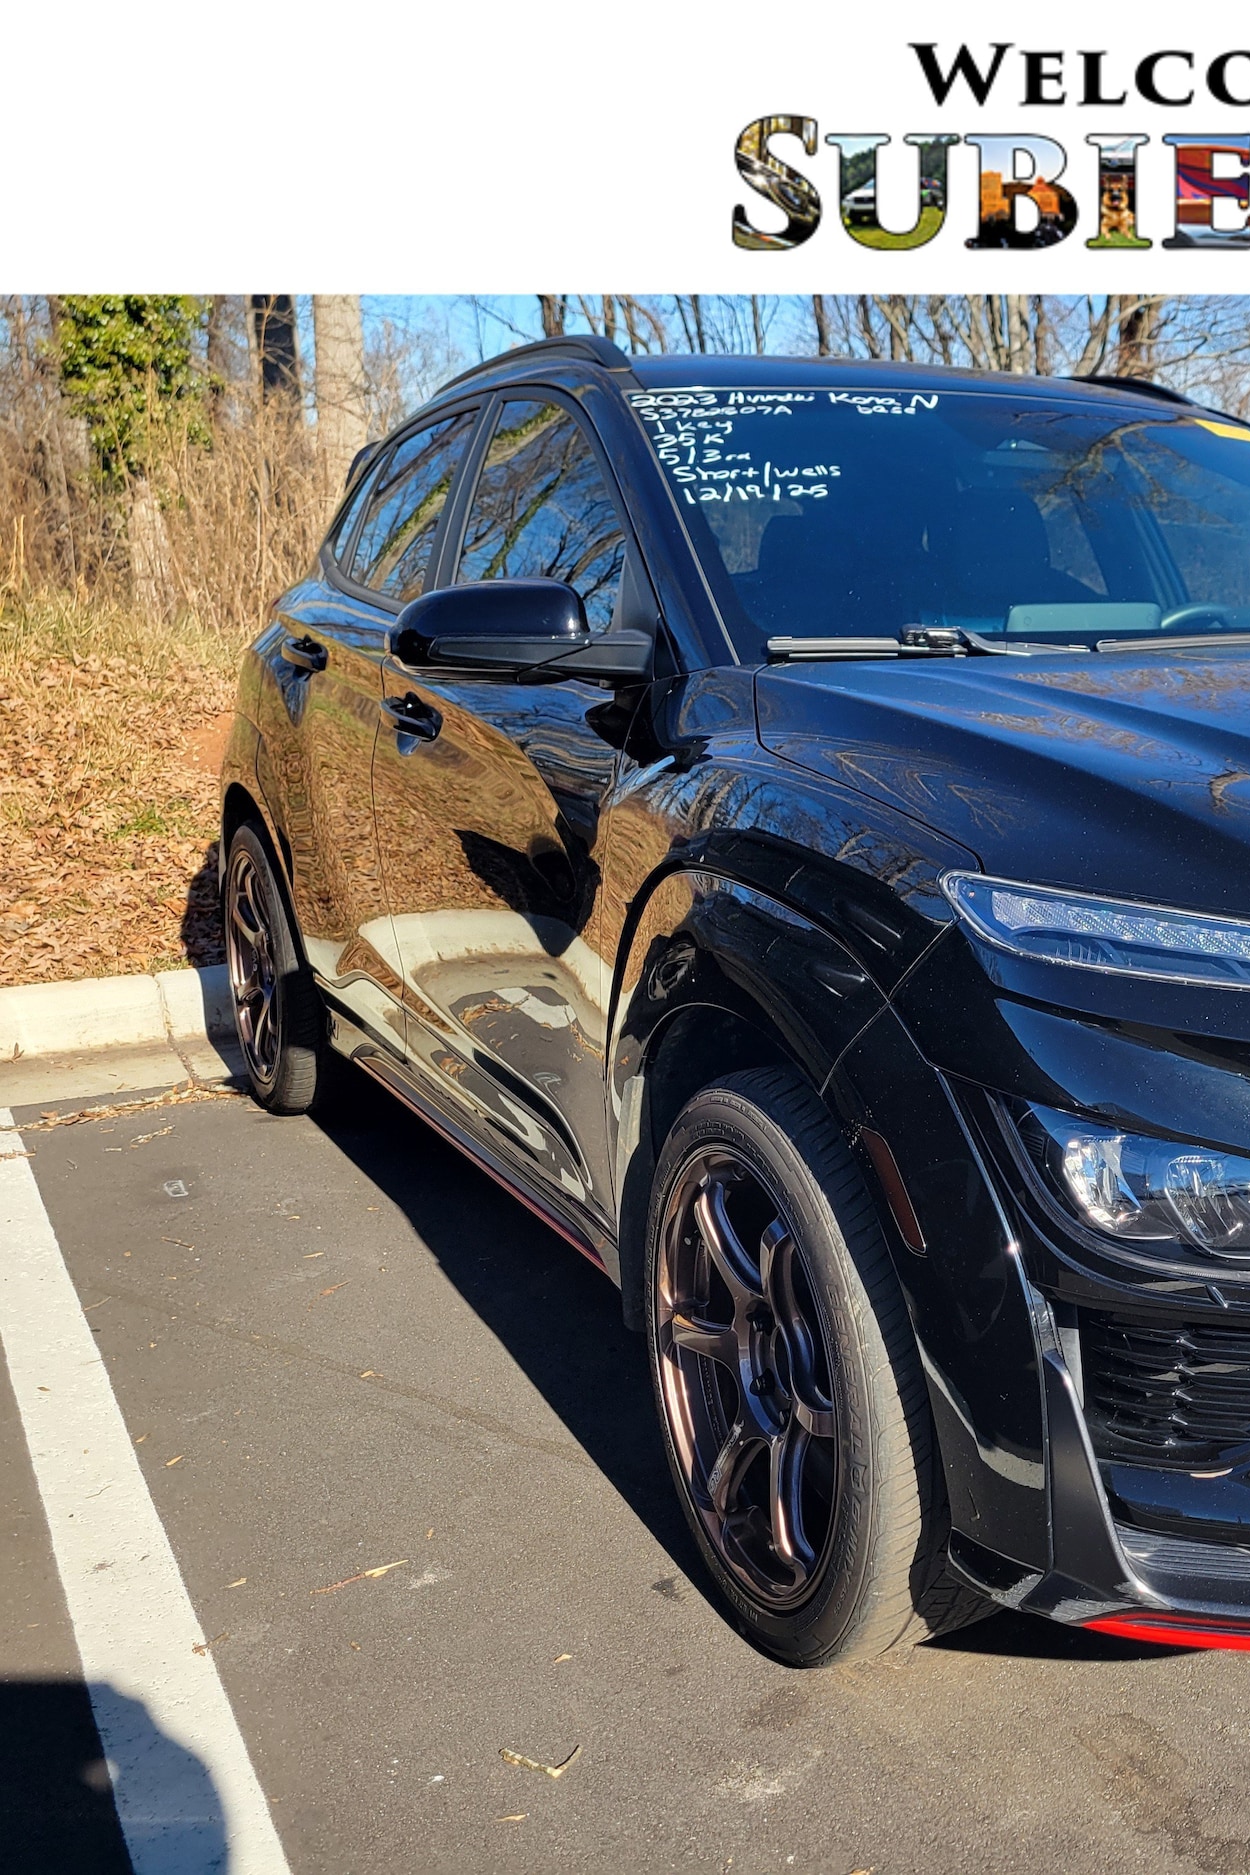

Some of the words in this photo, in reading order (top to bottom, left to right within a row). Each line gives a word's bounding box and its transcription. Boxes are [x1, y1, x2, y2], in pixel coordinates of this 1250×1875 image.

[631, 393, 718, 408] 2023
[910, 394, 939, 409] N
[826, 1284, 863, 1454] GENERAL
